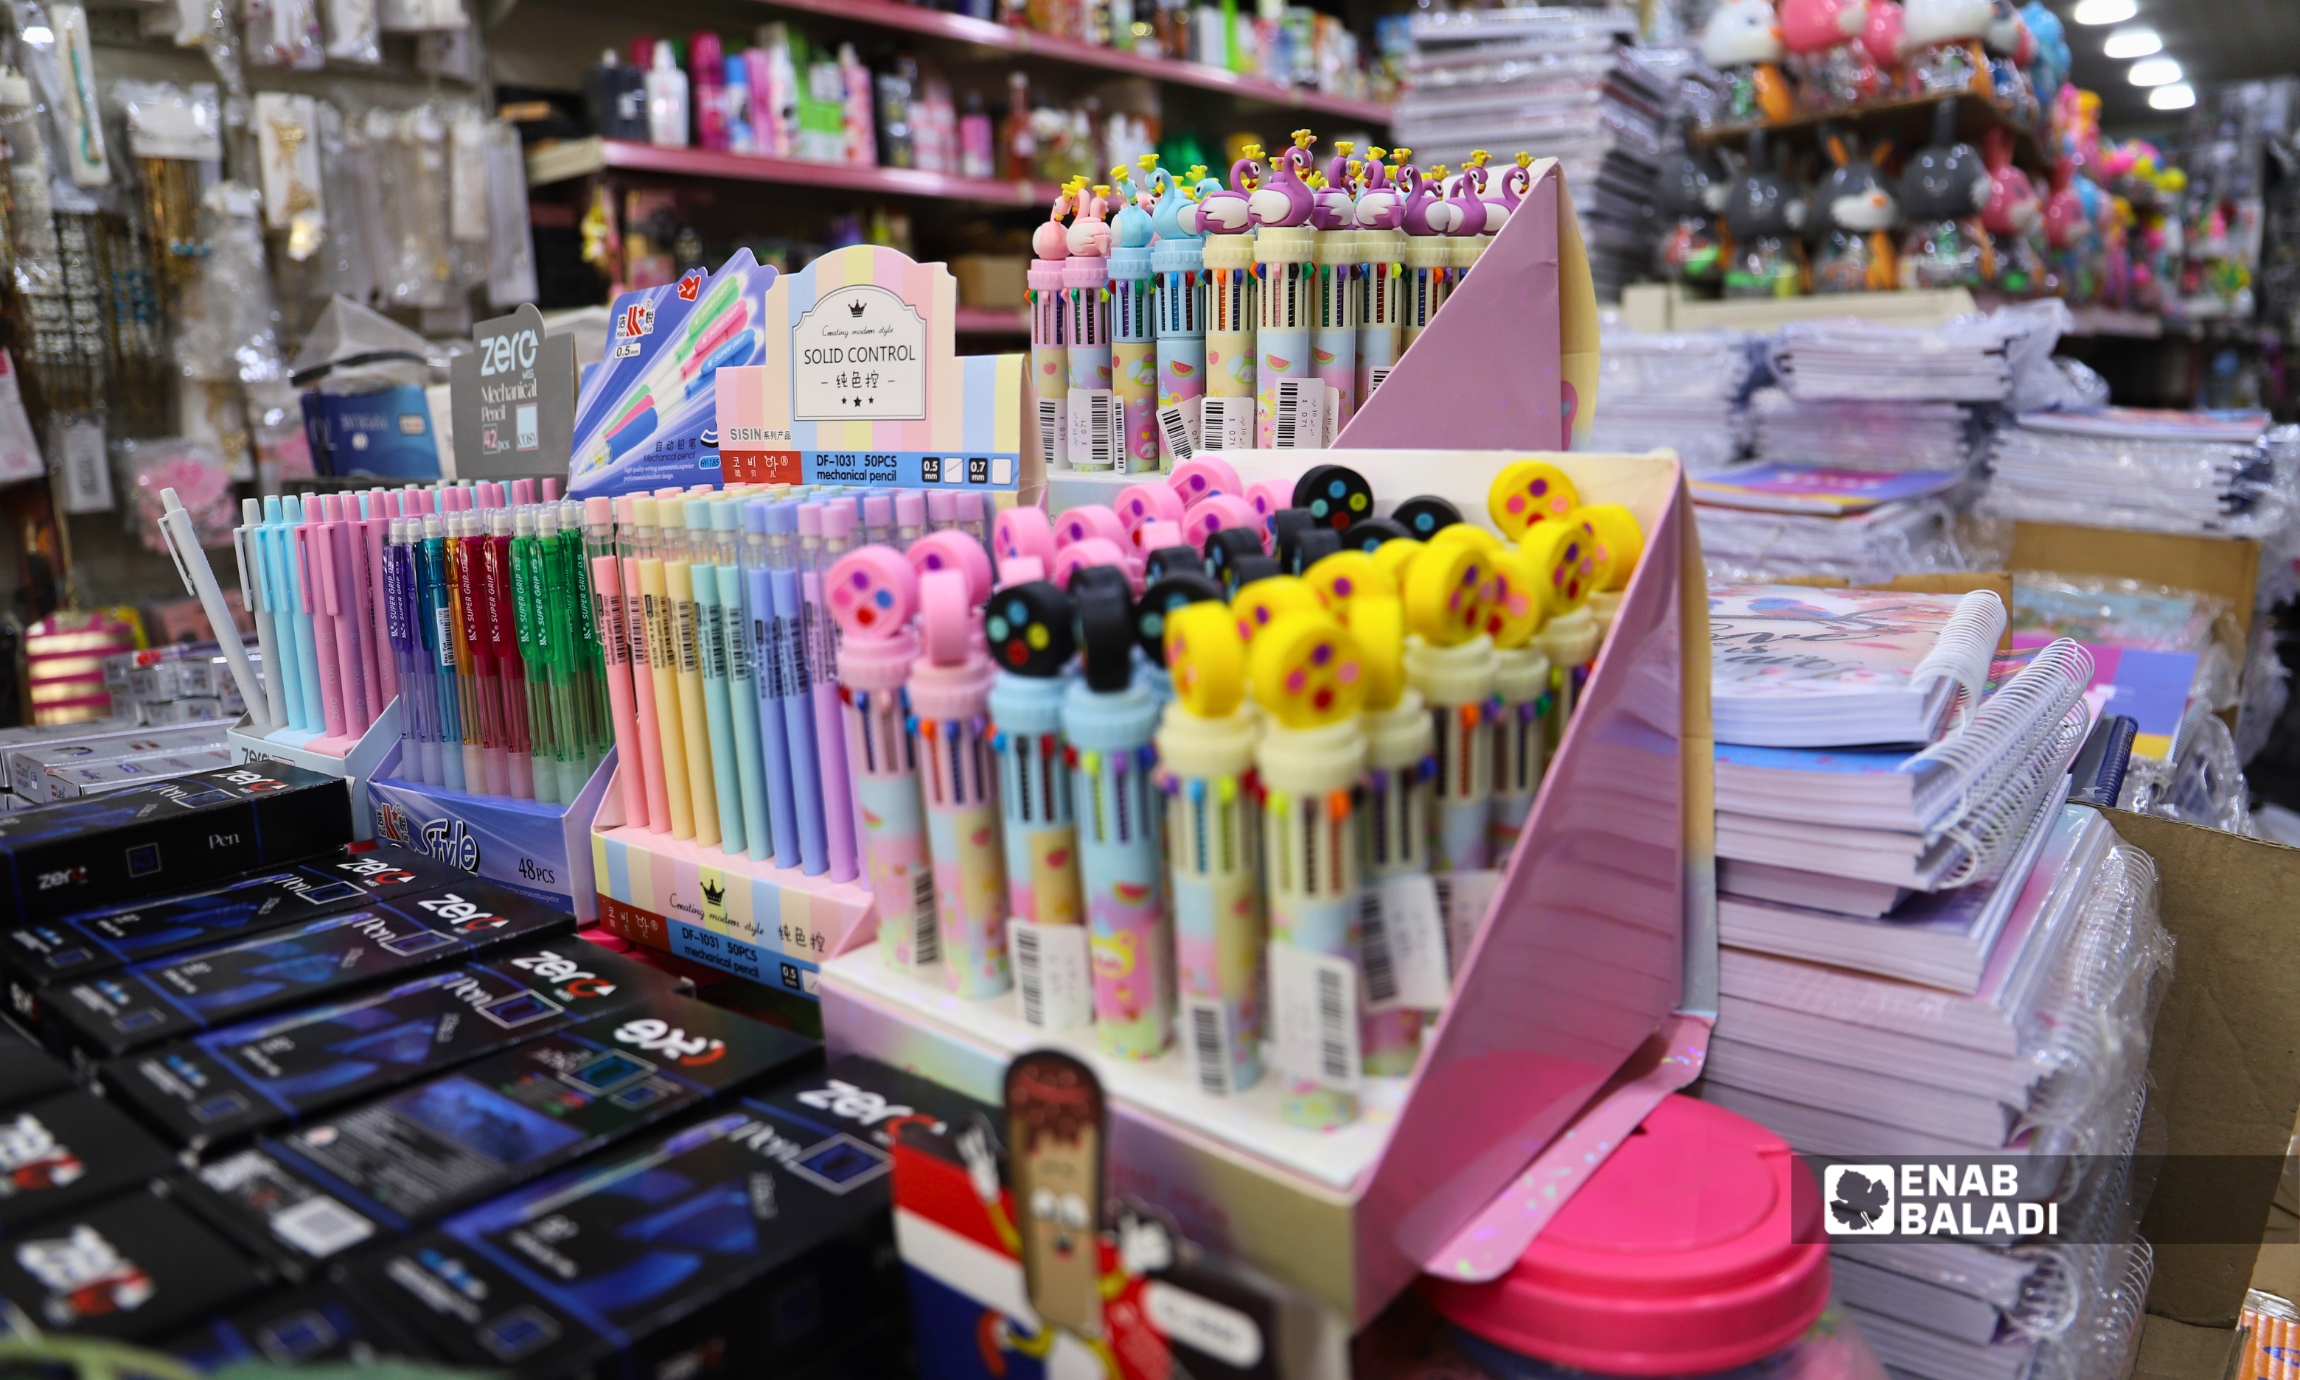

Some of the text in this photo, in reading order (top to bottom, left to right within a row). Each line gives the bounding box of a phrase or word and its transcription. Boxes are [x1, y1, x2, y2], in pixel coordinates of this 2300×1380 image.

[822, 324, 893, 339] Creating modern style
[804, 345, 916, 365] SOLID CONTROL
[481, 378, 537, 404] Mechanical
[482, 404, 506, 423] Pencil
[730, 428, 761, 440] SISIN
[763, 430, 791, 440] 系列产品
[655, 437, 697, 452] 自动铅笔
[644, 451, 696, 463] Mechanical pencil
[700, 458, 720, 468] HY-185
[816, 454, 897, 468] DF-1031 50PCS
[923, 461, 938, 472] 0.5
[817, 469, 897, 483] mechanical pencil
[970, 461, 985, 473] 0.7
[463, 575, 475, 622] SUPER GRIP
[487, 574, 498, 622] SUPER GRIP
[516, 573, 527, 622] SUPER GRIP
[533, 576, 545, 626] SUPER GRIP
[578, 571, 589, 620] SUPER GRIP
[655, 620, 663, 636] pencil
[607, 636, 616, 664] mechanical
[657, 638, 667, 668] mechanical
[209, 833, 240, 849] Pen
[417, 818, 480, 871] Style
[518, 857, 555, 885] 48PCS
[669, 893, 765, 937] Creating modern style
[682, 927, 758, 962] DF-1031 50PCS
[685, 945, 760, 978] mechanical pencil
[782, 965, 797, 980] 0.5
